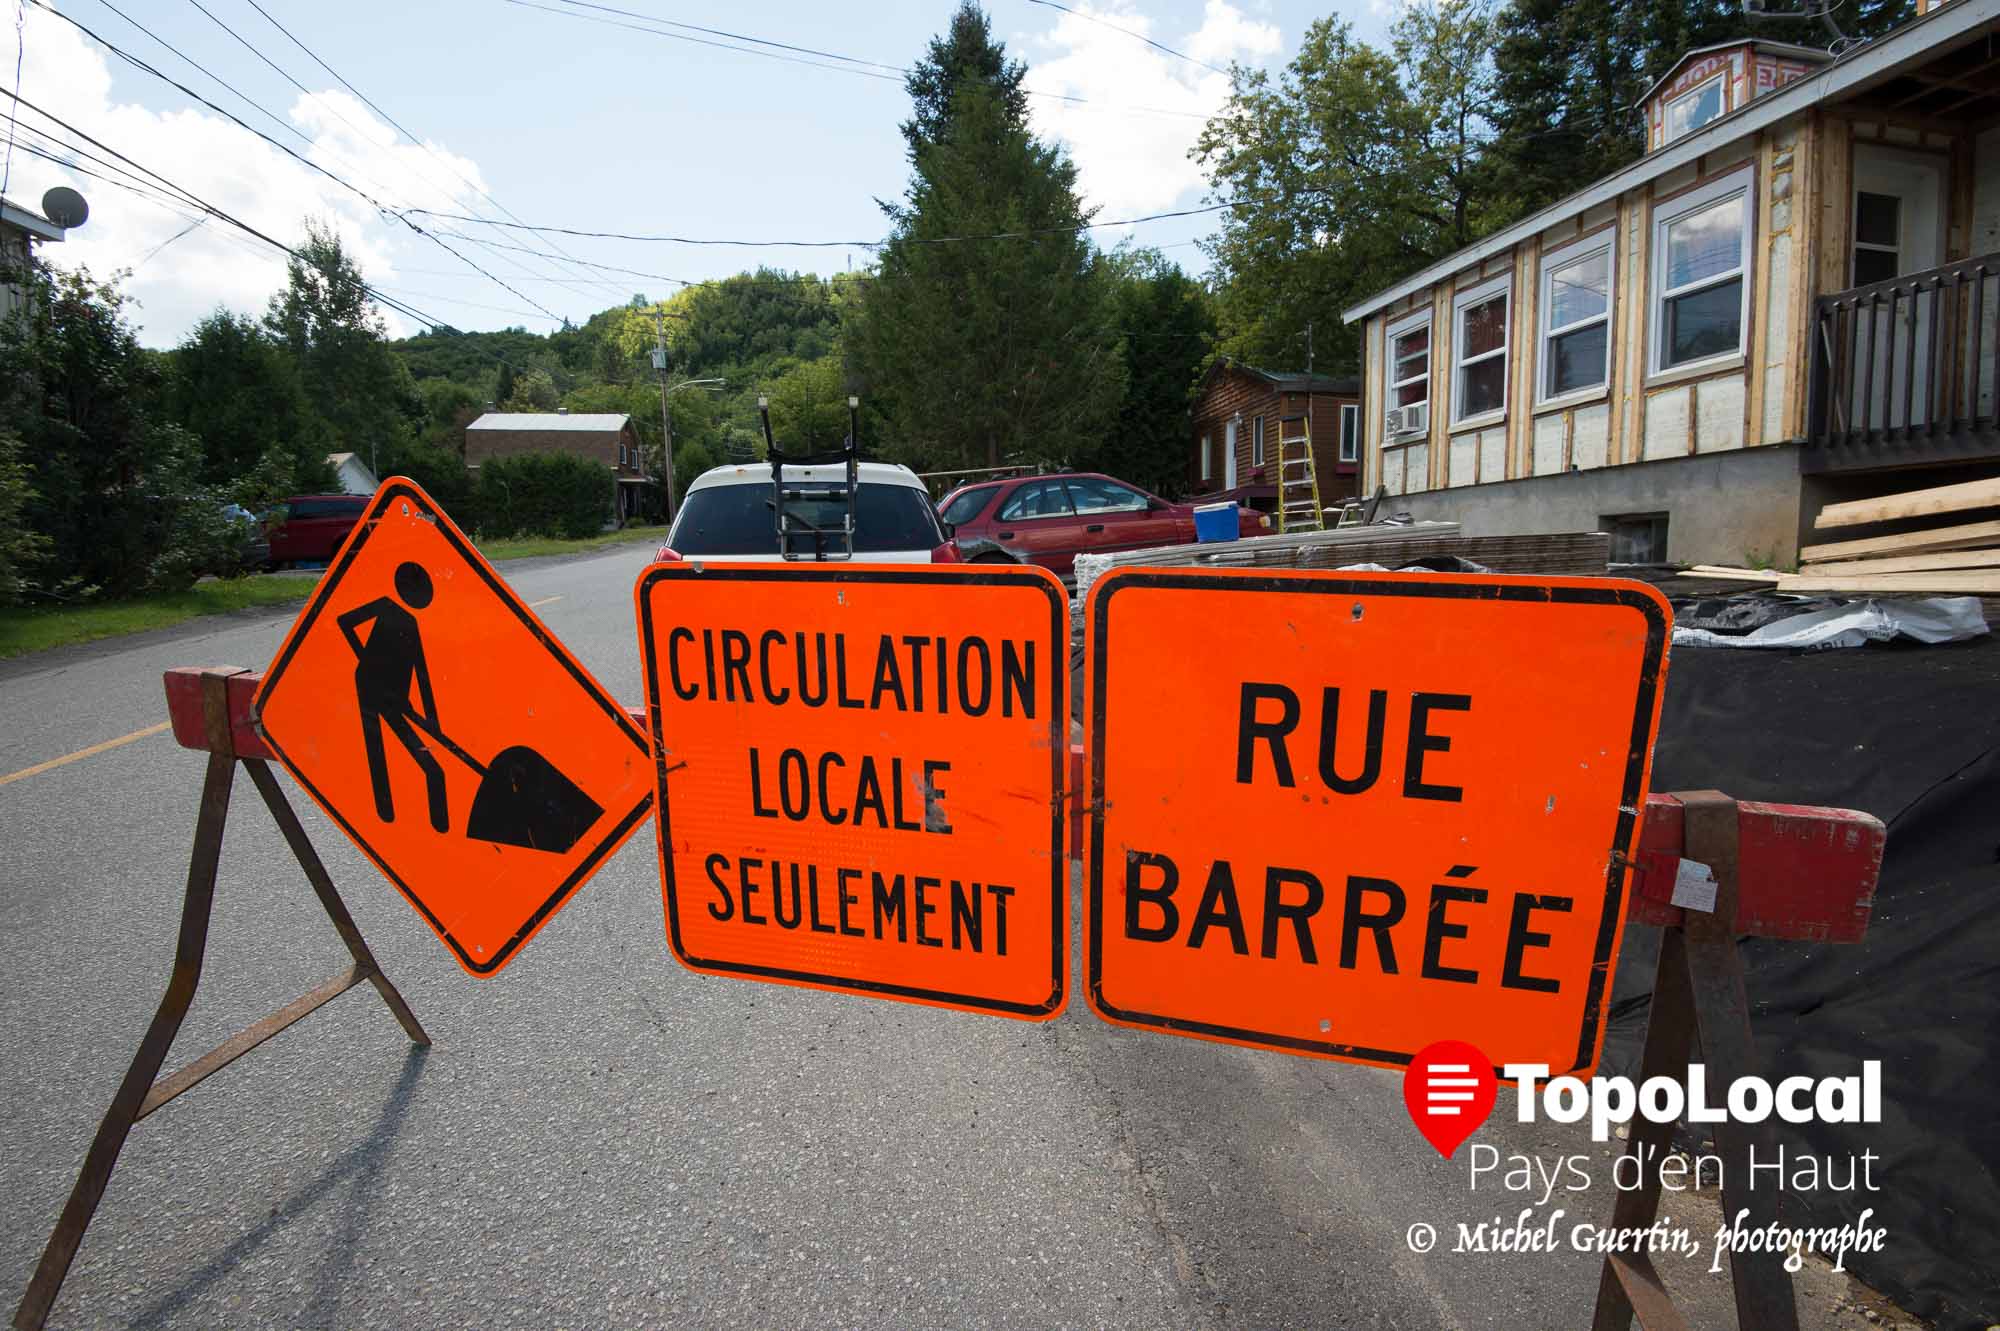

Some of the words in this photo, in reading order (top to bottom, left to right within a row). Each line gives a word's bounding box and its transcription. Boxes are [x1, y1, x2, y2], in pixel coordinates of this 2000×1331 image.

[669, 626, 1036, 720] CIRCULATION
[749, 747, 953, 835] LOCALE
[1236, 681, 1472, 803] RUE
[704, 853, 1016, 957] SEULEMENT
[1124, 849, 1574, 994] BARRÉE
